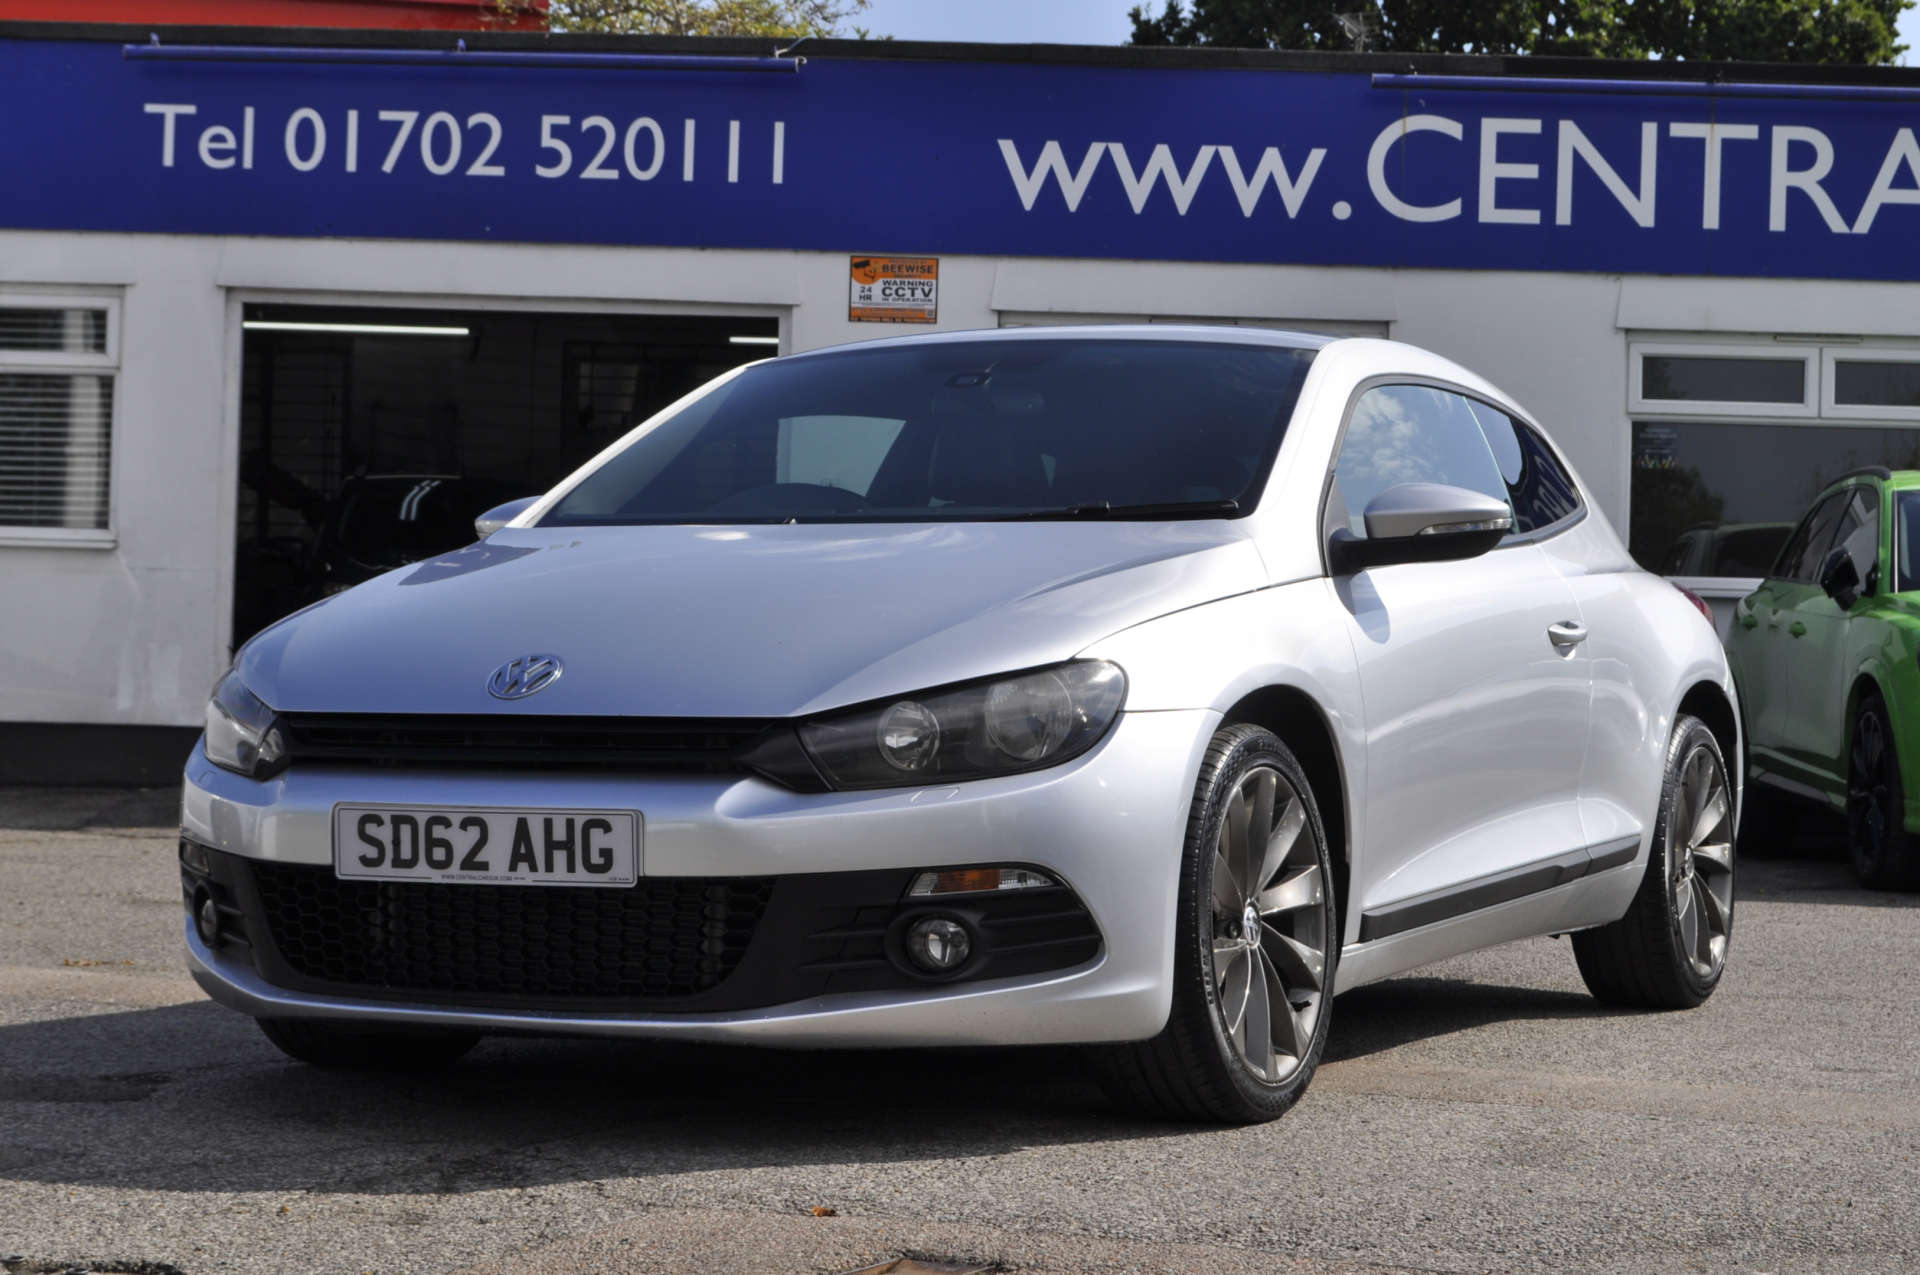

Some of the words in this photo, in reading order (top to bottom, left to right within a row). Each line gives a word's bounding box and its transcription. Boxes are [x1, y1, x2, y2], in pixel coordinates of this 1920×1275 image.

[143, 103, 254, 170] Tel
[284, 107, 505, 177] 01702
[535, 114, 785, 184] 520111
[997, 115, 1920, 234] www.CENTRA
[881, 287, 933, 297] CCTV
[882, 264, 933, 273] BEEWISE
[357, 813, 490, 872] SD62
[508, 816, 614, 874] AHG
